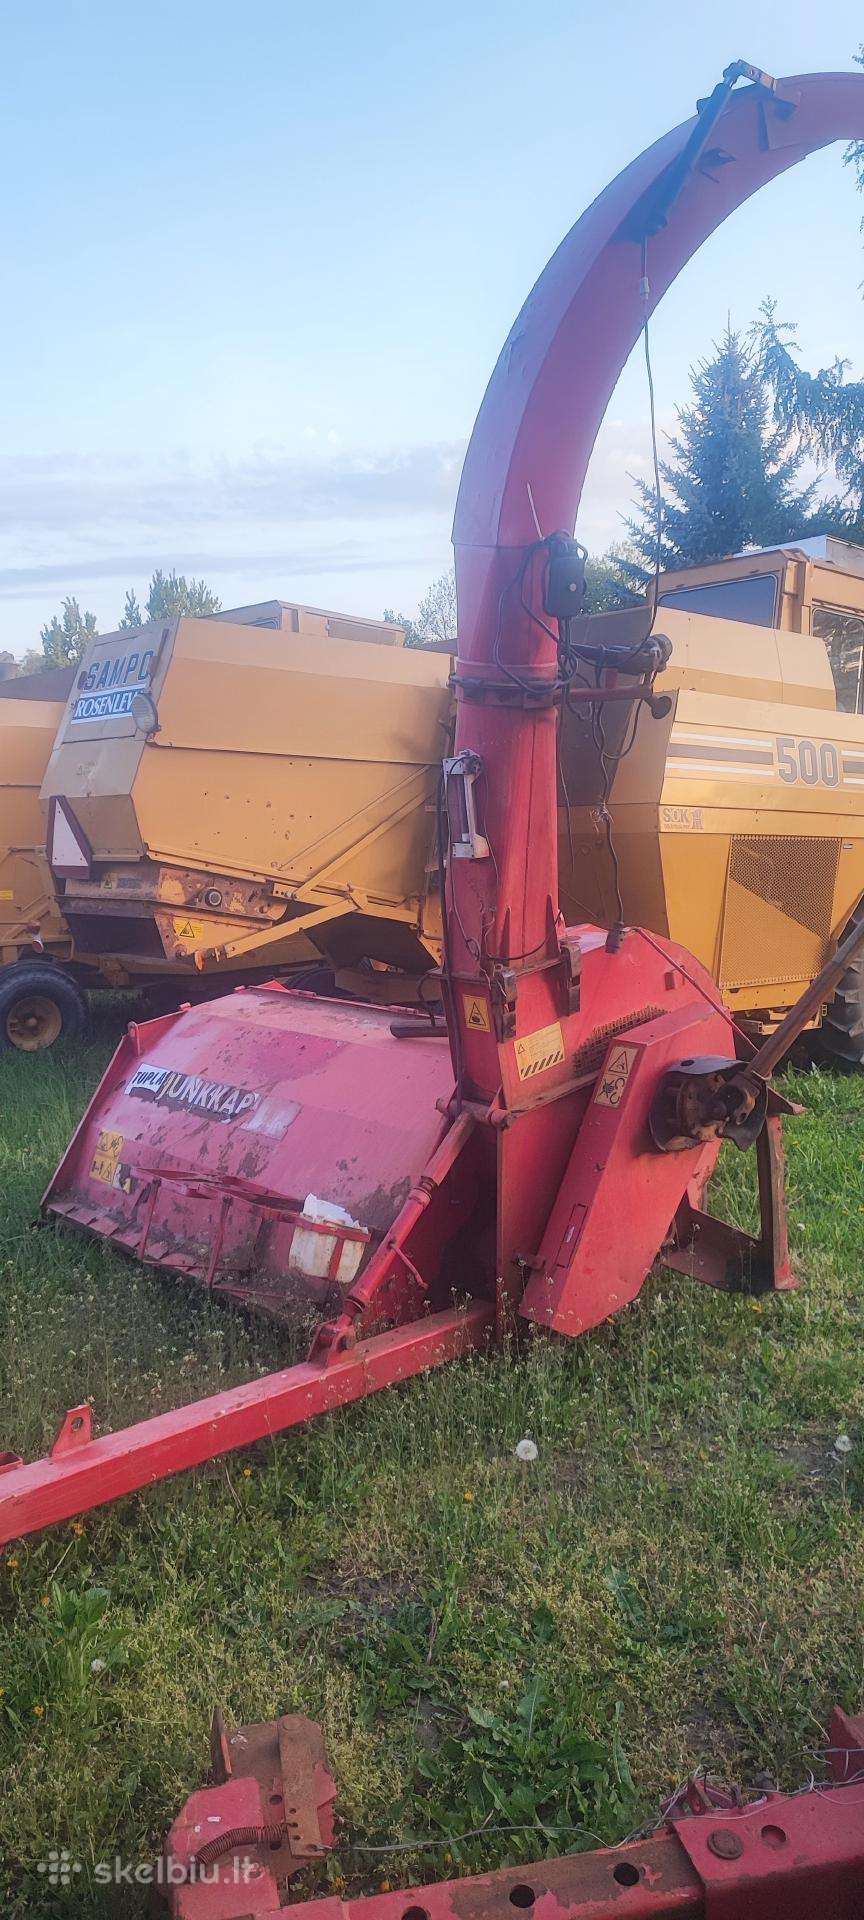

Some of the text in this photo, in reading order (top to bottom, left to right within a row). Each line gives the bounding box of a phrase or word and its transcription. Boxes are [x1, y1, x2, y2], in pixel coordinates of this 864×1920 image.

[84, 649, 154, 691] SAMPO
[776, 736, 839, 788] 500
[131, 1070, 167, 1088] TUPLA
